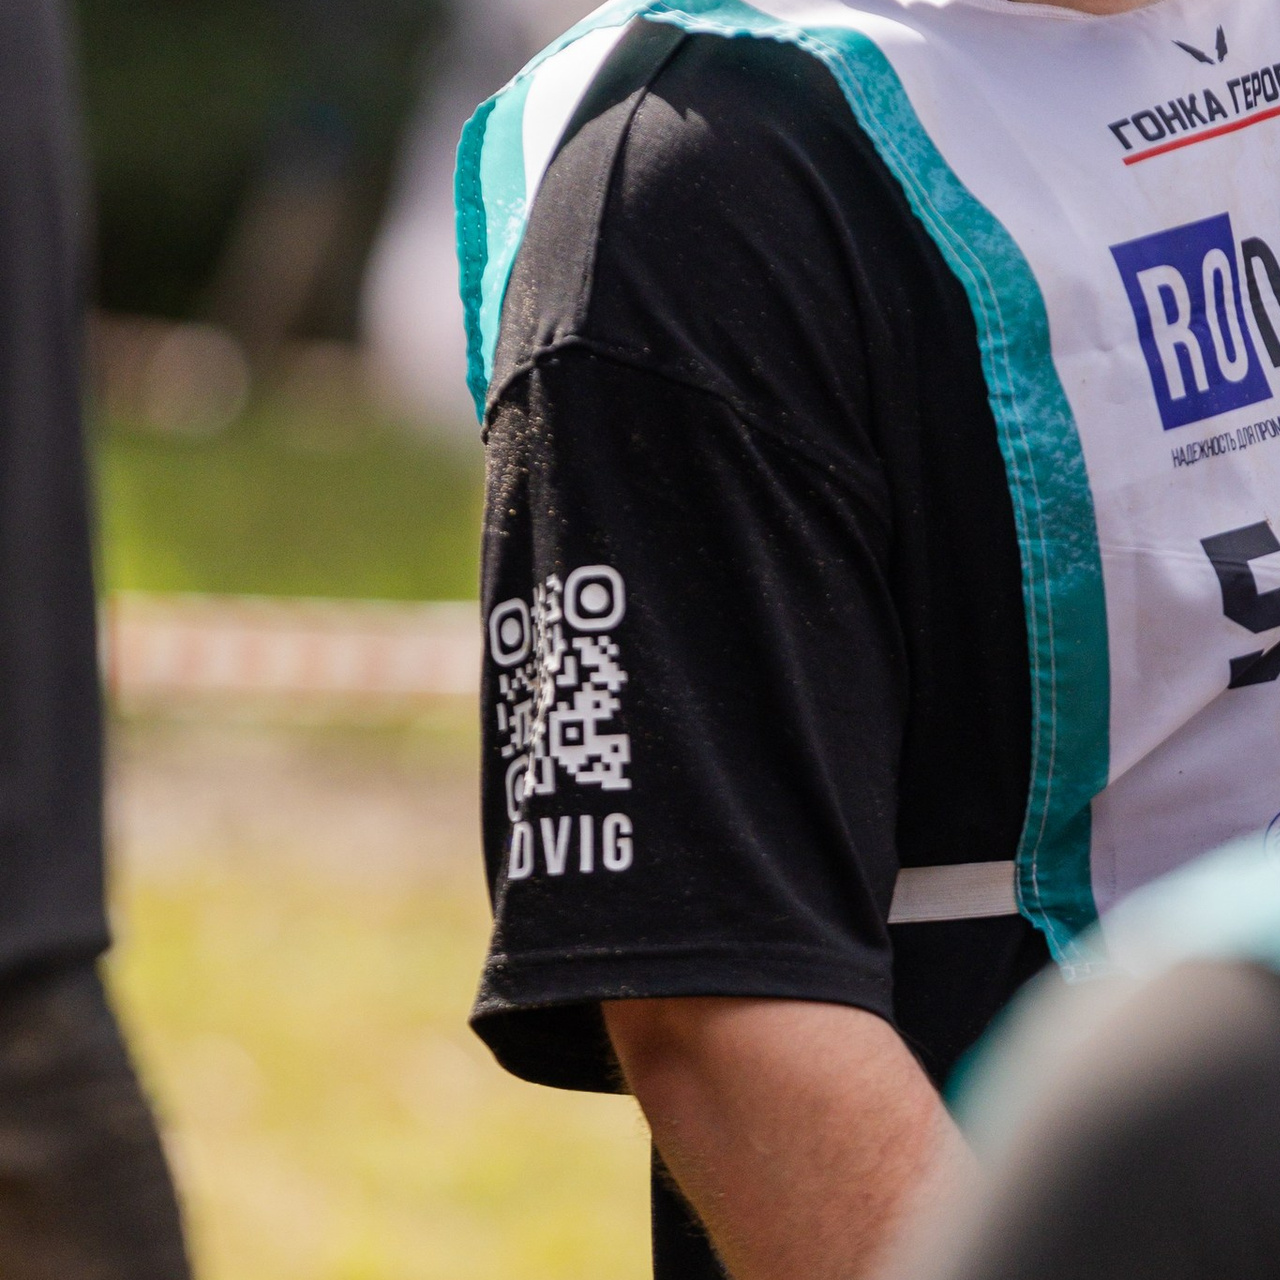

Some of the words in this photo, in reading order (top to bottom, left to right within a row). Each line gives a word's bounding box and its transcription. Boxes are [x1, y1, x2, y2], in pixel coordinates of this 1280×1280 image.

[1107, 87, 1229, 151] ГОНКА
[1171, 431, 1237, 468] НАДЕЖНОСТЬ
[1236, 424, 1257, 452] ДЛЯ
